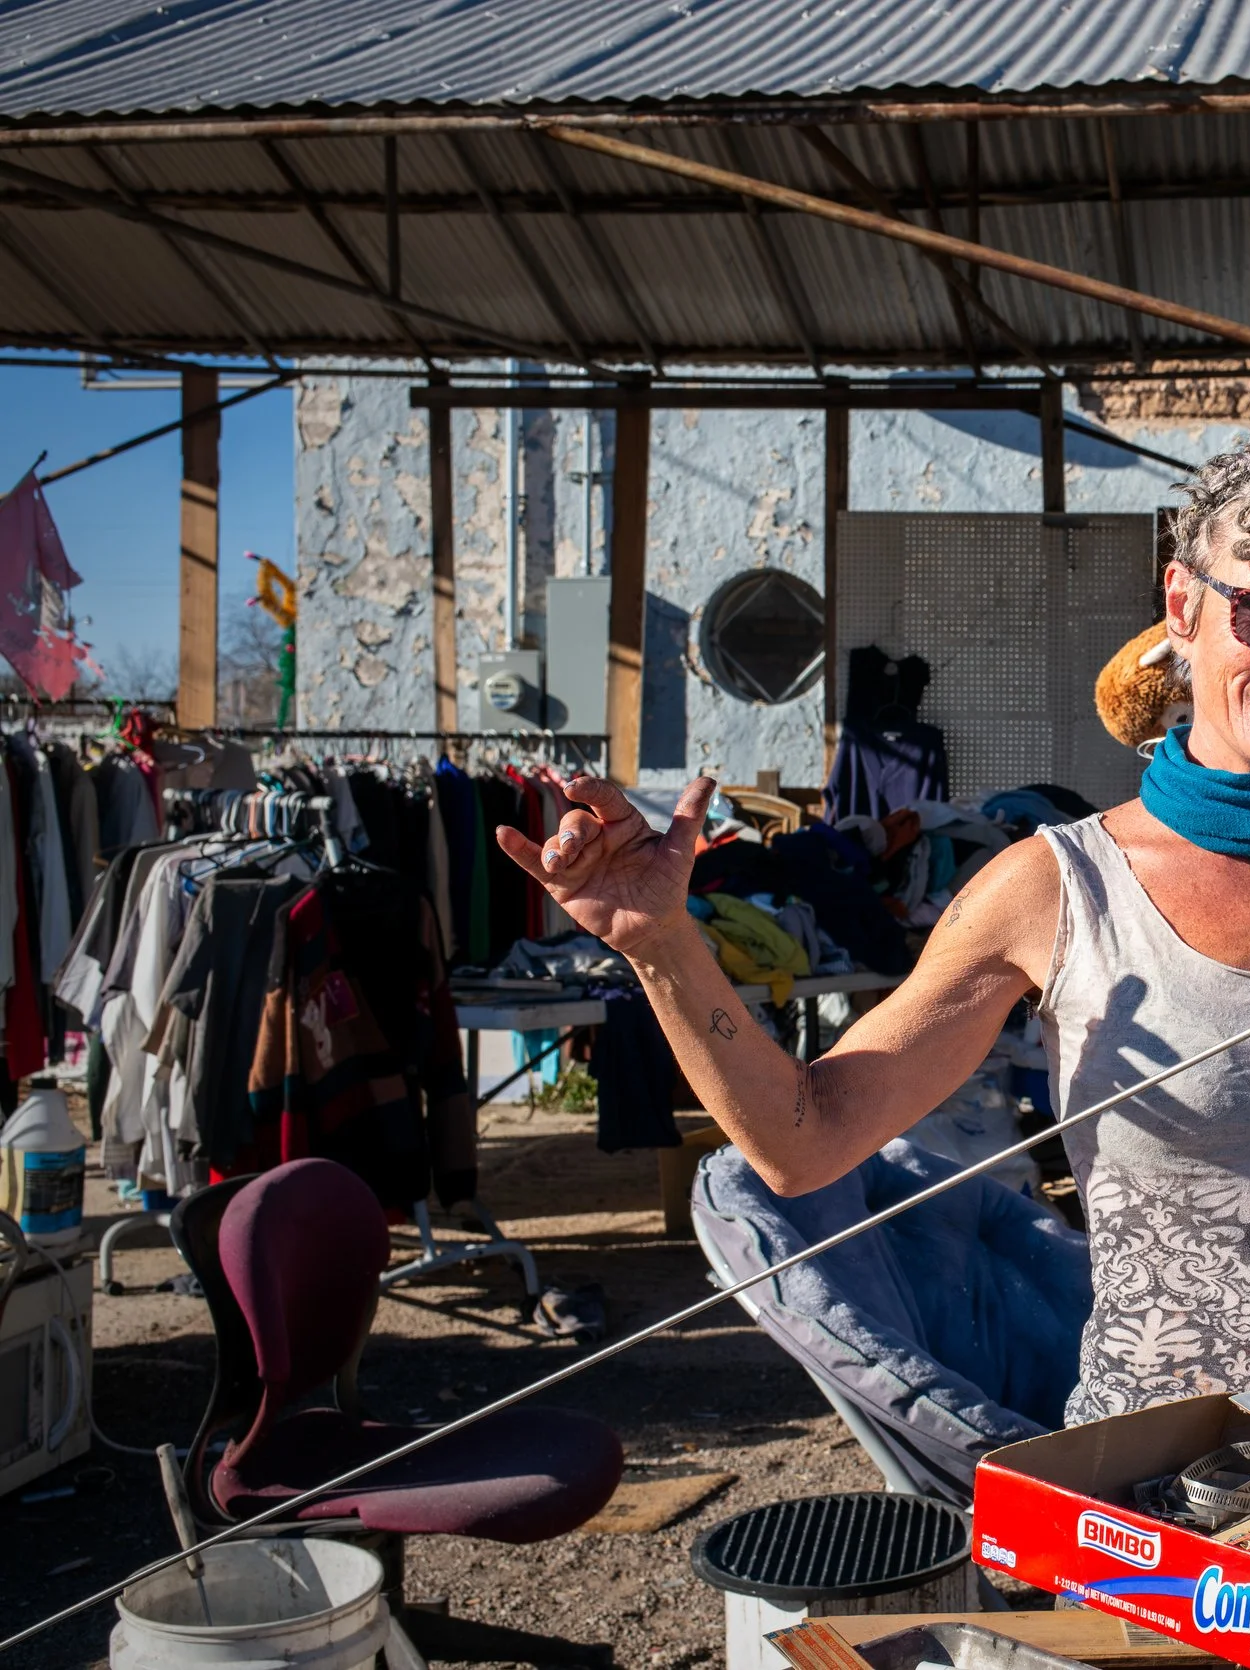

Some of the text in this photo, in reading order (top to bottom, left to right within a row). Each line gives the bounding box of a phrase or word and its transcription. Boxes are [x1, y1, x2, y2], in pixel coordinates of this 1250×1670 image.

[1084, 1519, 1155, 1561] BIMBO
[1070, 1581, 1077, 1592] OZ
[1090, 1588, 1100, 1601] NET
[1140, 1608, 1147, 1619] LB
[1157, 1614, 1164, 1626] OZ
